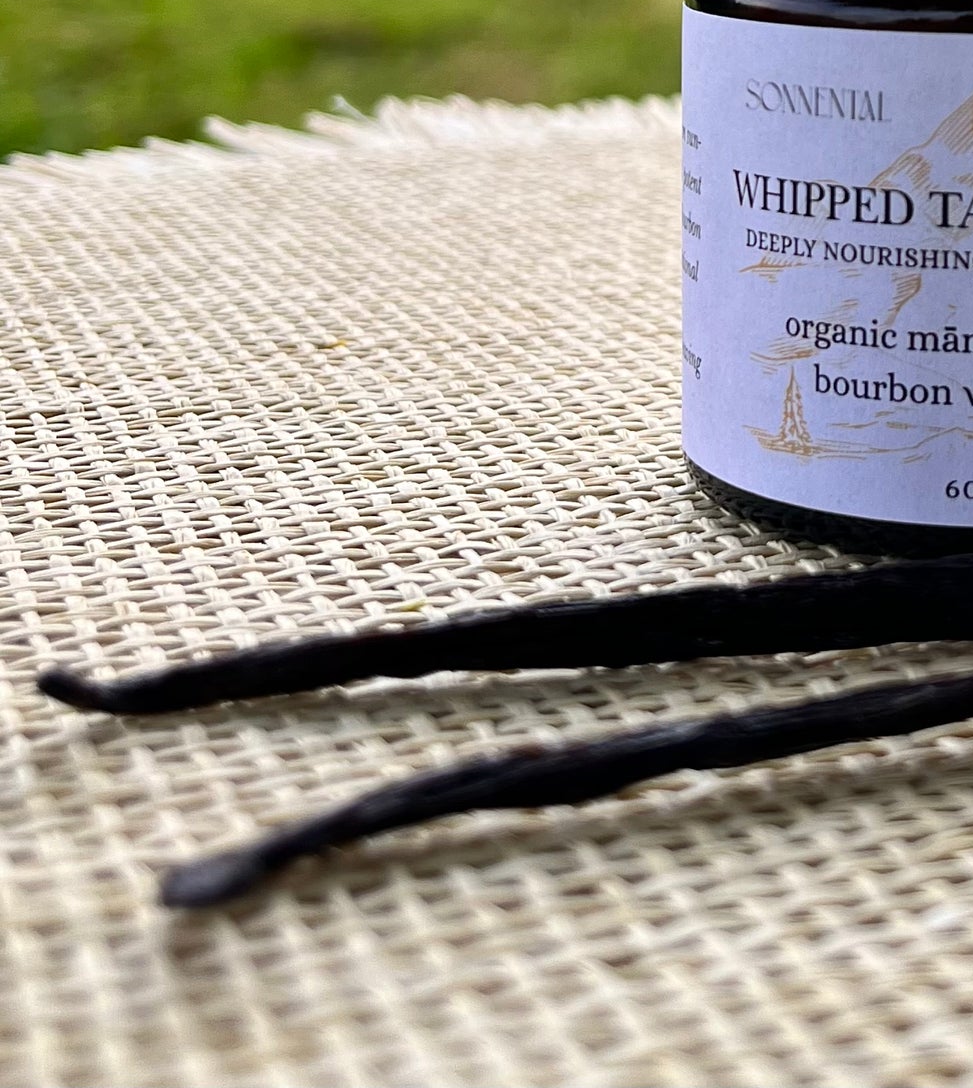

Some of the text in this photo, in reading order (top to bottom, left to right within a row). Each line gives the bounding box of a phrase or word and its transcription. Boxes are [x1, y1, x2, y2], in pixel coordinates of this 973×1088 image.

[745, 79, 893, 124] SONNENTAL
[732, 168, 914, 227] WHIPPED
[745, 227, 818, 260] DEEPLY
[784, 315, 898, 352] organic
[813, 363, 954, 408] bourbon
